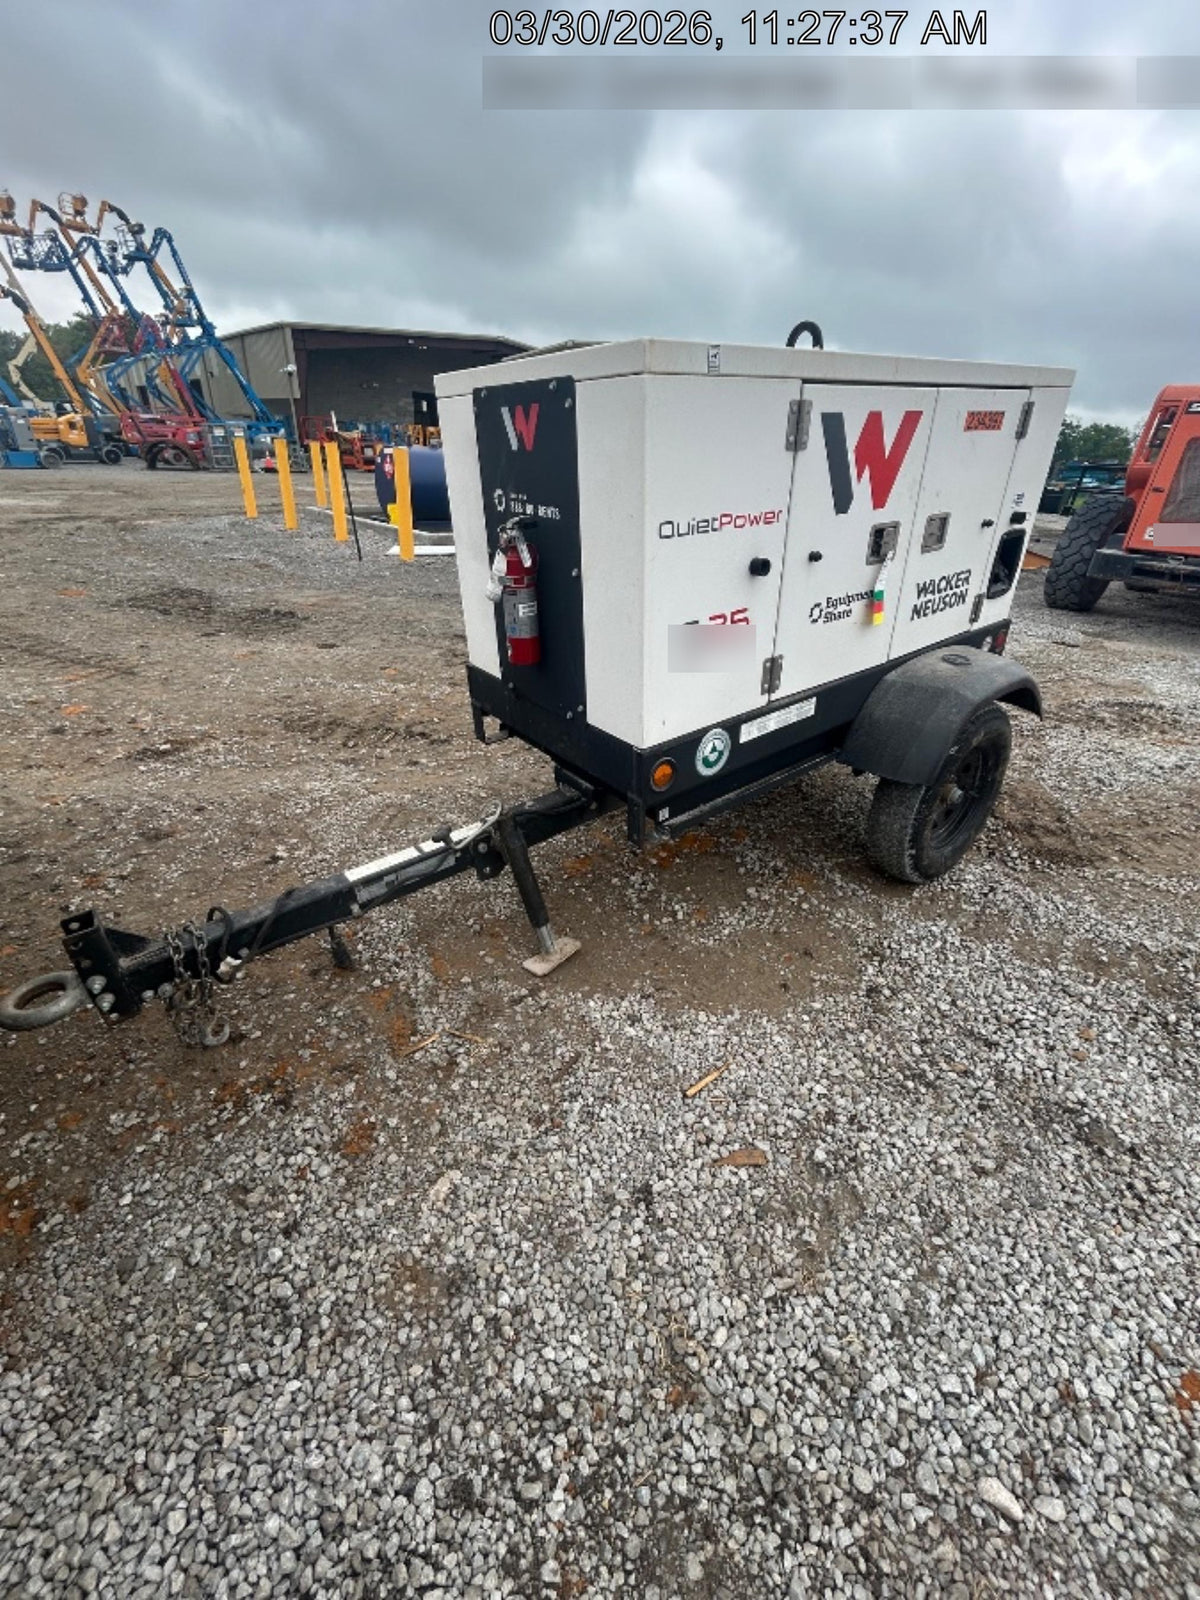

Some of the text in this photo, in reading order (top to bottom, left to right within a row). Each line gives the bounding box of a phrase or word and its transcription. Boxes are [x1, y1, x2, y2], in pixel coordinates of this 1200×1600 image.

[658, 509, 784, 539] QuietPower
[916, 569, 972, 599] WACKER
[823, 608, 853, 624] Share
[910, 588, 969, 621] NEUSON
